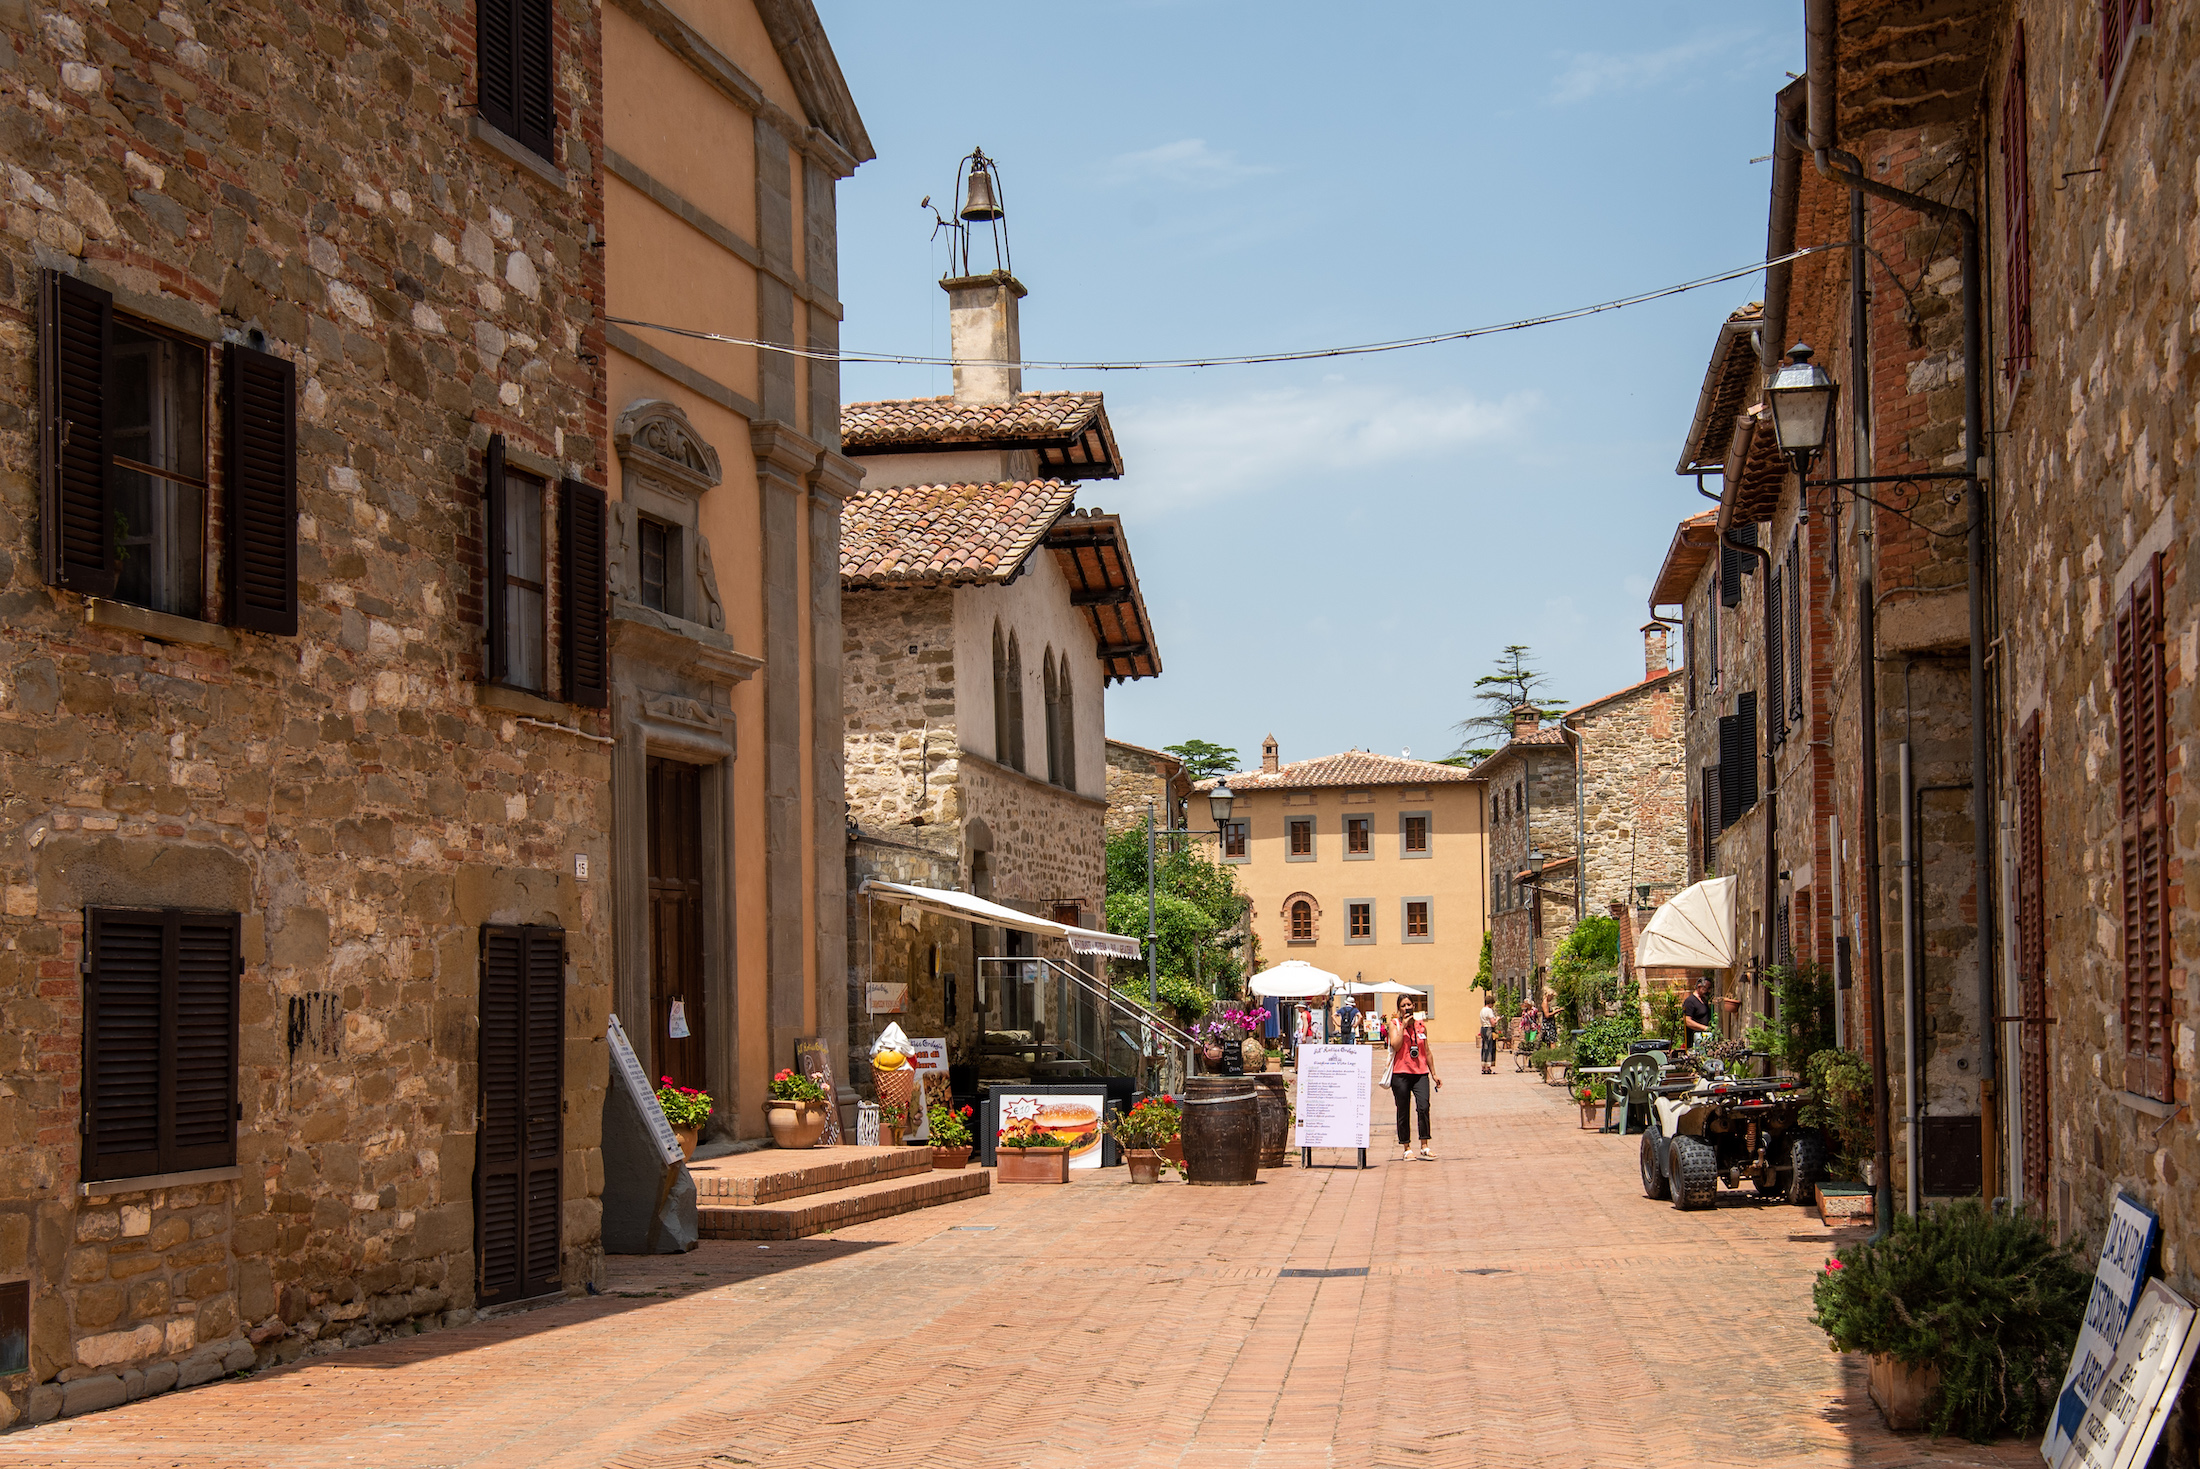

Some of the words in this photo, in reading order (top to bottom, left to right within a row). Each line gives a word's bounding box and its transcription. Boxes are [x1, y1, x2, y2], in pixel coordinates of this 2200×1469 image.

[578, 863, 586, 875] 15
[916, 1061, 937, 1069] tura
[930, 1050, 940, 1058] di
[2084, 1276, 2128, 1352] RISTORANTE
[2075, 1349, 2106, 1402] ALBER
[2119, 1363, 2138, 1391] BAR
[2099, 1378, 2136, 1425] RISTORANTE
[2084, 1412, 2110, 1450] PIZZERIA
